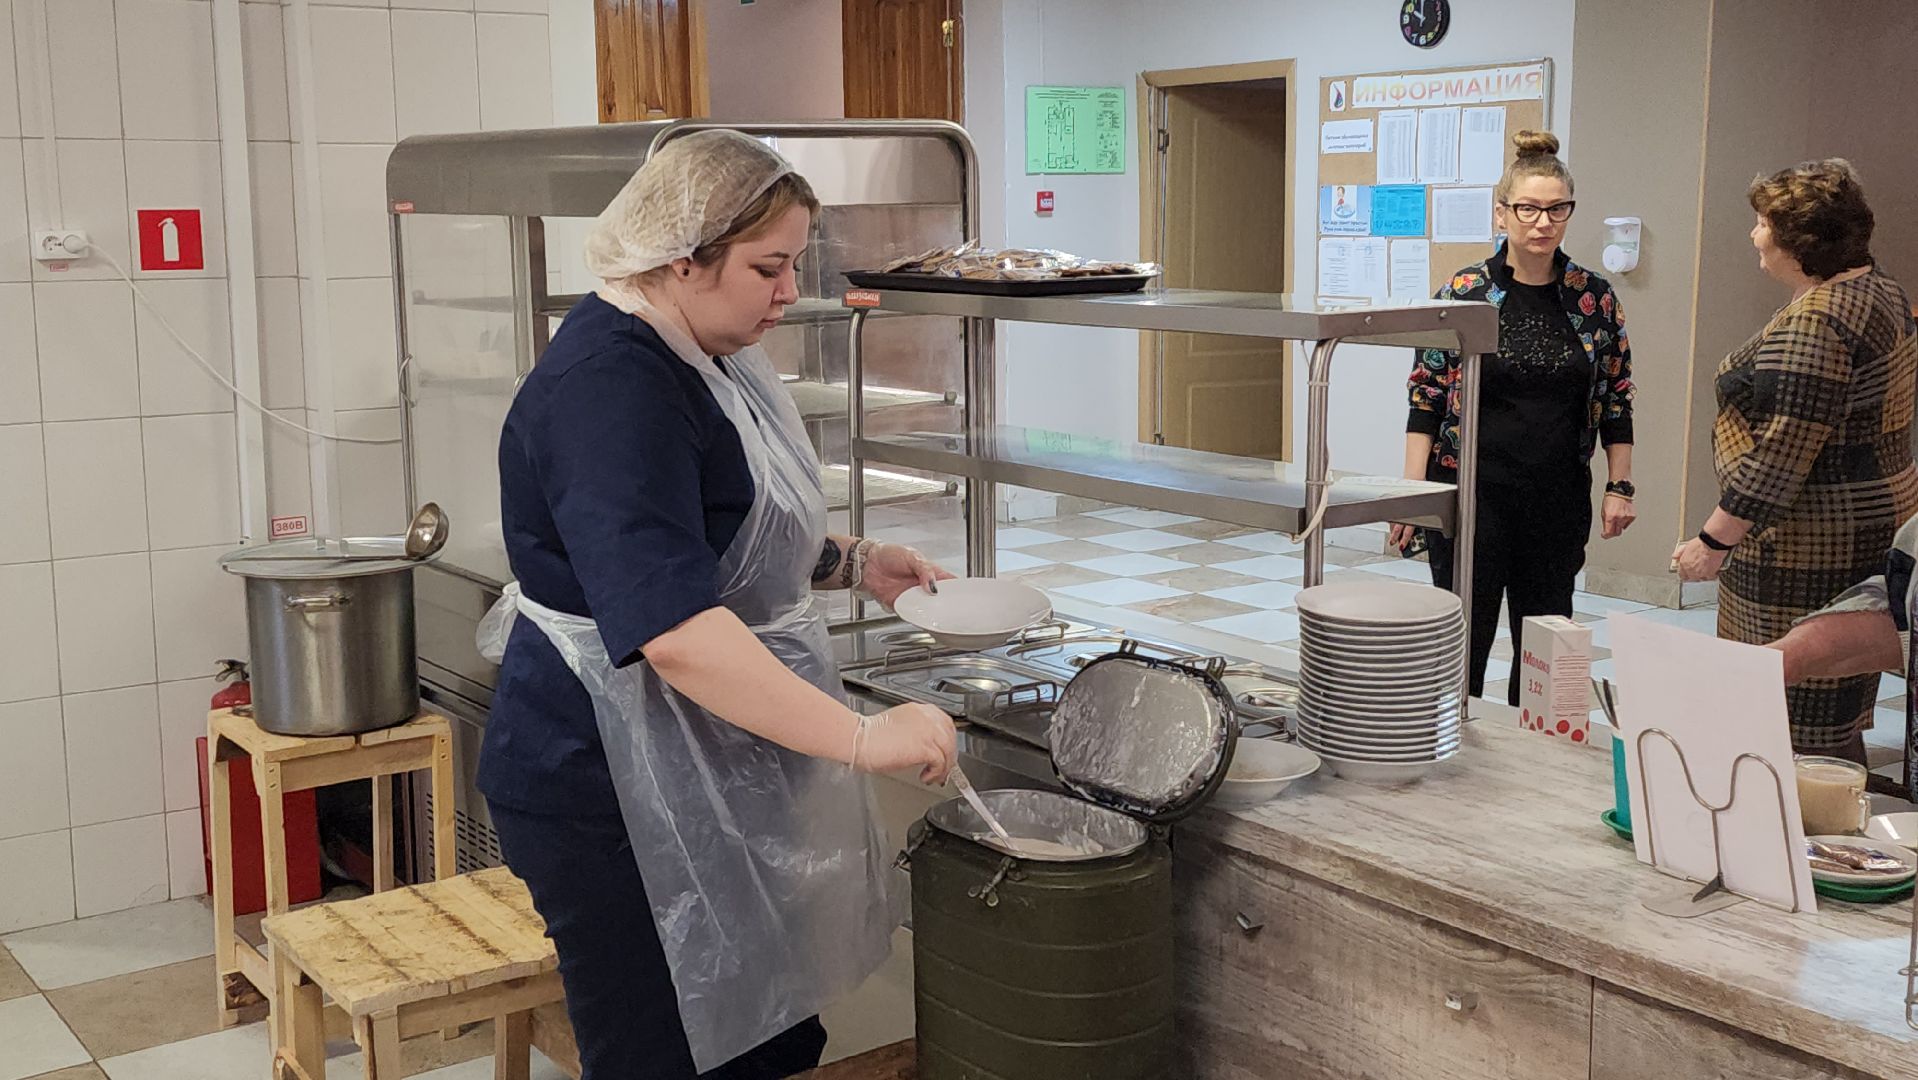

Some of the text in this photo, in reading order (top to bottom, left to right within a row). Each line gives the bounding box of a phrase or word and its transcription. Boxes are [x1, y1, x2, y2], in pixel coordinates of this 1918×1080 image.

[1403, 14, 1410, 24] 9
[1411, 33, 1418, 43] 7
[1355, 71, 1542, 102] ИНФОРМАЦИЯ
[275, 521, 303, 531] 380В
